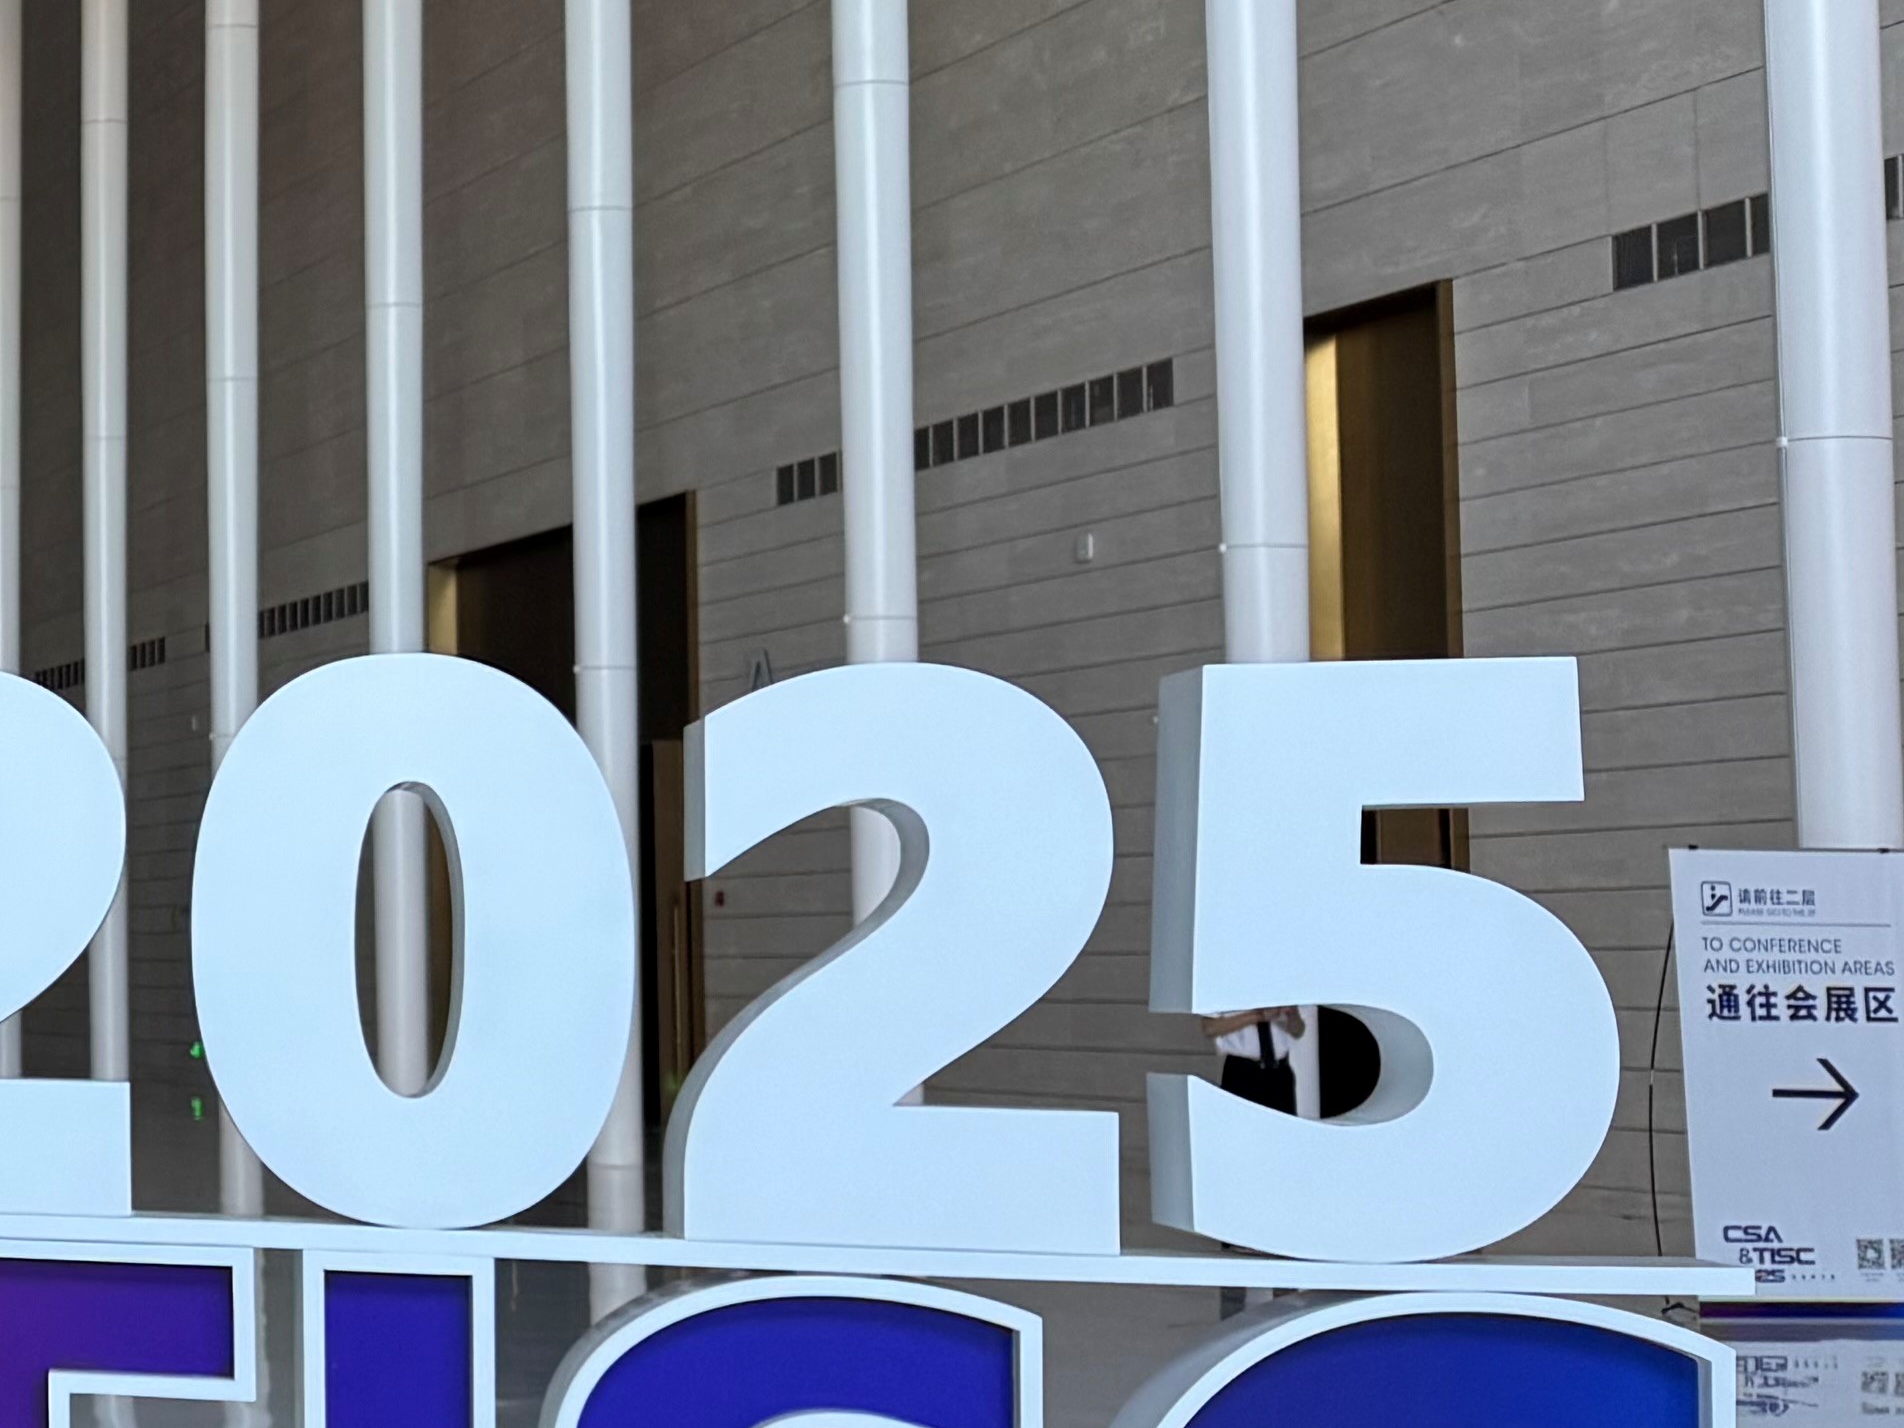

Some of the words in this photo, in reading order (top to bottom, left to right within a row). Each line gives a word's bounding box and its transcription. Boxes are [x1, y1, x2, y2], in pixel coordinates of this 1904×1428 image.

[1701, 936, 1724, 953] TO
[1729, 937, 1842, 954] CONFERENCE
[1703, 958, 1740, 974] AND
[1746, 959, 1836, 976] EXHIBITION
[1841, 960, 1896, 977] AREAS
[1706, 983, 1900, 1023] 通往会展区
[1722, 1225, 1784, 1243] CSA
